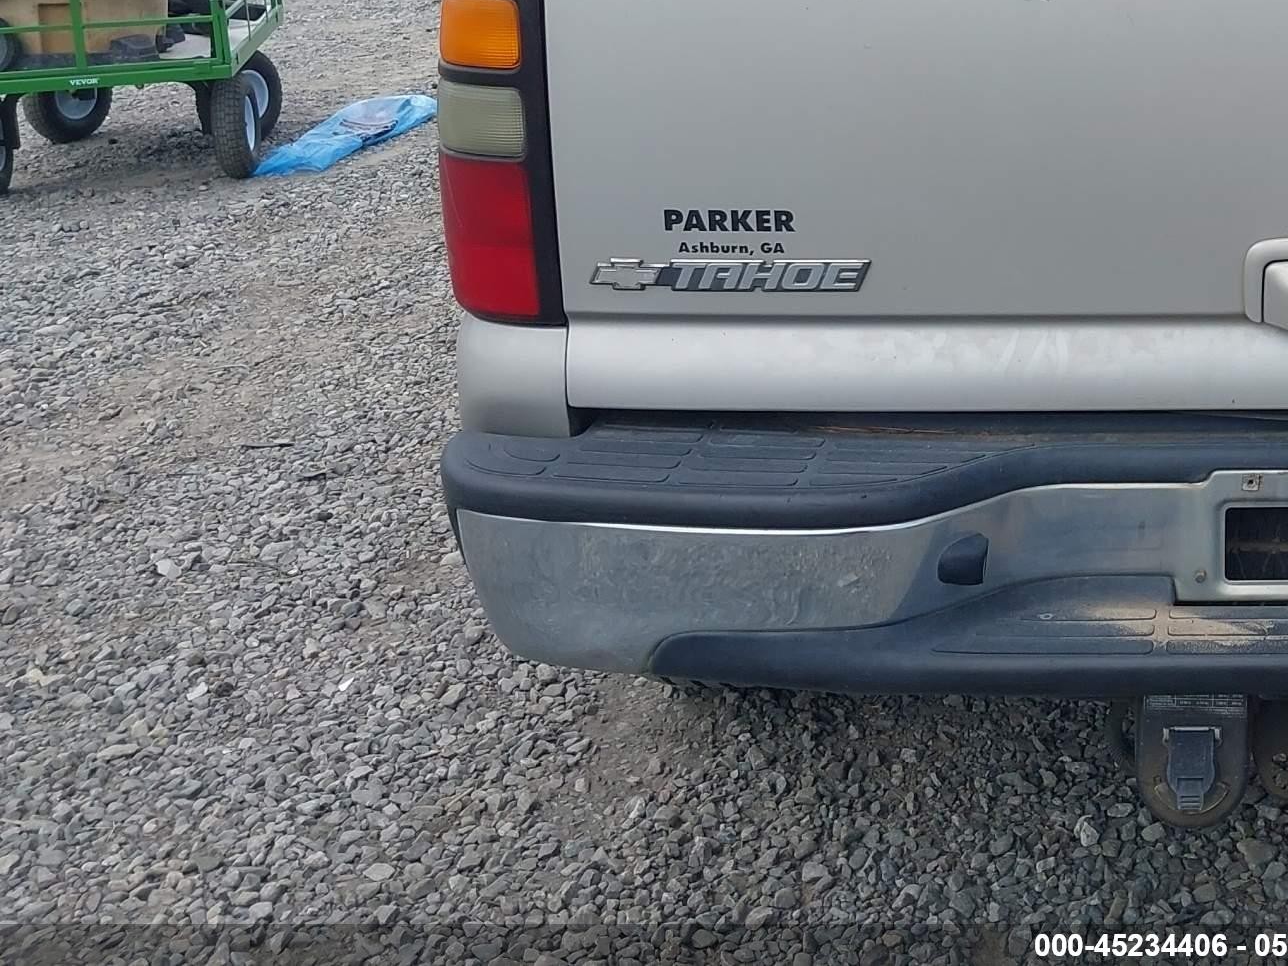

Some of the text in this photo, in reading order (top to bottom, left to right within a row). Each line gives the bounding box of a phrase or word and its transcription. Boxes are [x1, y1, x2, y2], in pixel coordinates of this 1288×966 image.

[663, 209, 795, 233] PARKER
[678, 241, 785, 256] Ashburn, GA
[672, 261, 866, 290] TAHOE
